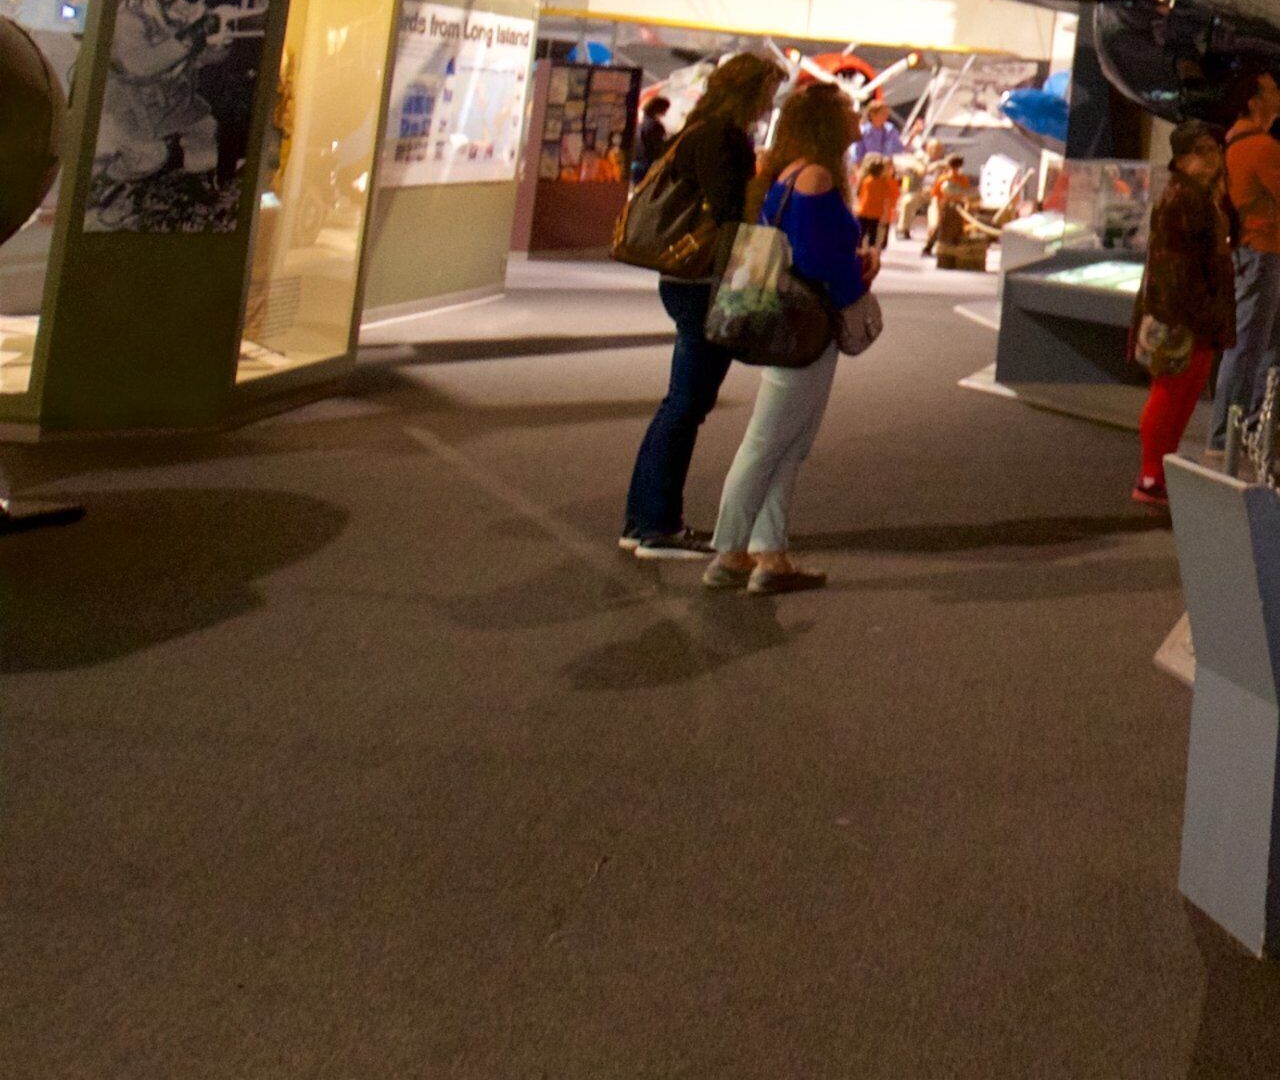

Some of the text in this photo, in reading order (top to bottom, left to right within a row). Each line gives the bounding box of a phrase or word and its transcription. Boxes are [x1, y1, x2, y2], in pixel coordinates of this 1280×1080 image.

[429, 13, 460, 39] from
[463, 17, 493, 48] Long
[496, 24, 530, 46] Island
